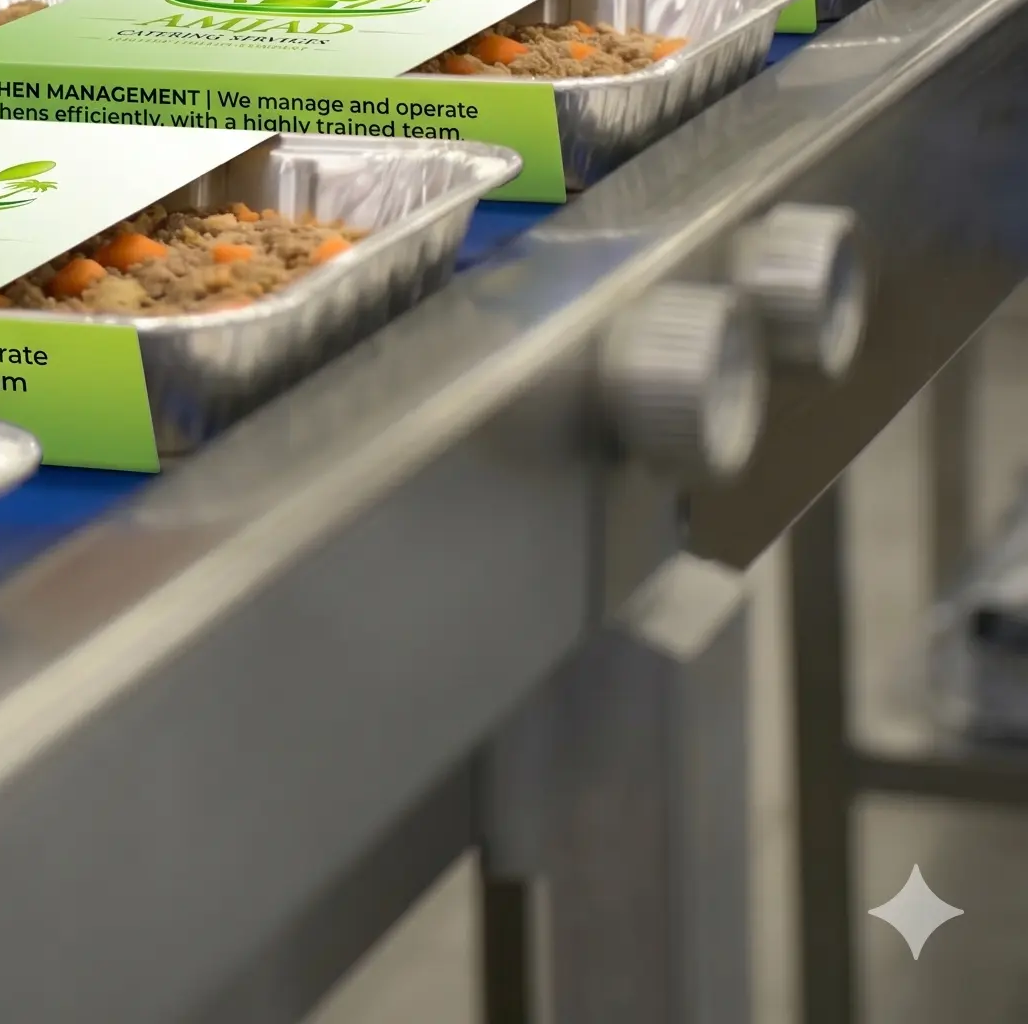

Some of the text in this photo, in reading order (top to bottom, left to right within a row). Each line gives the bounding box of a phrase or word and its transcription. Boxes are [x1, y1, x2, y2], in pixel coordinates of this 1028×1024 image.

[134, 13, 354, 35] AMJAD
[47, 84, 200, 107] MANAGEMENT
[218, 91, 251, 109] We
[258, 95, 344, 115] manage
[350, 98, 389, 115] and
[396, 102, 479, 120] operate
[170, 111, 218, 129] with
[225, 116, 237, 130] a
[244, 114, 310, 135] highly
[316, 119, 395, 139] trained
